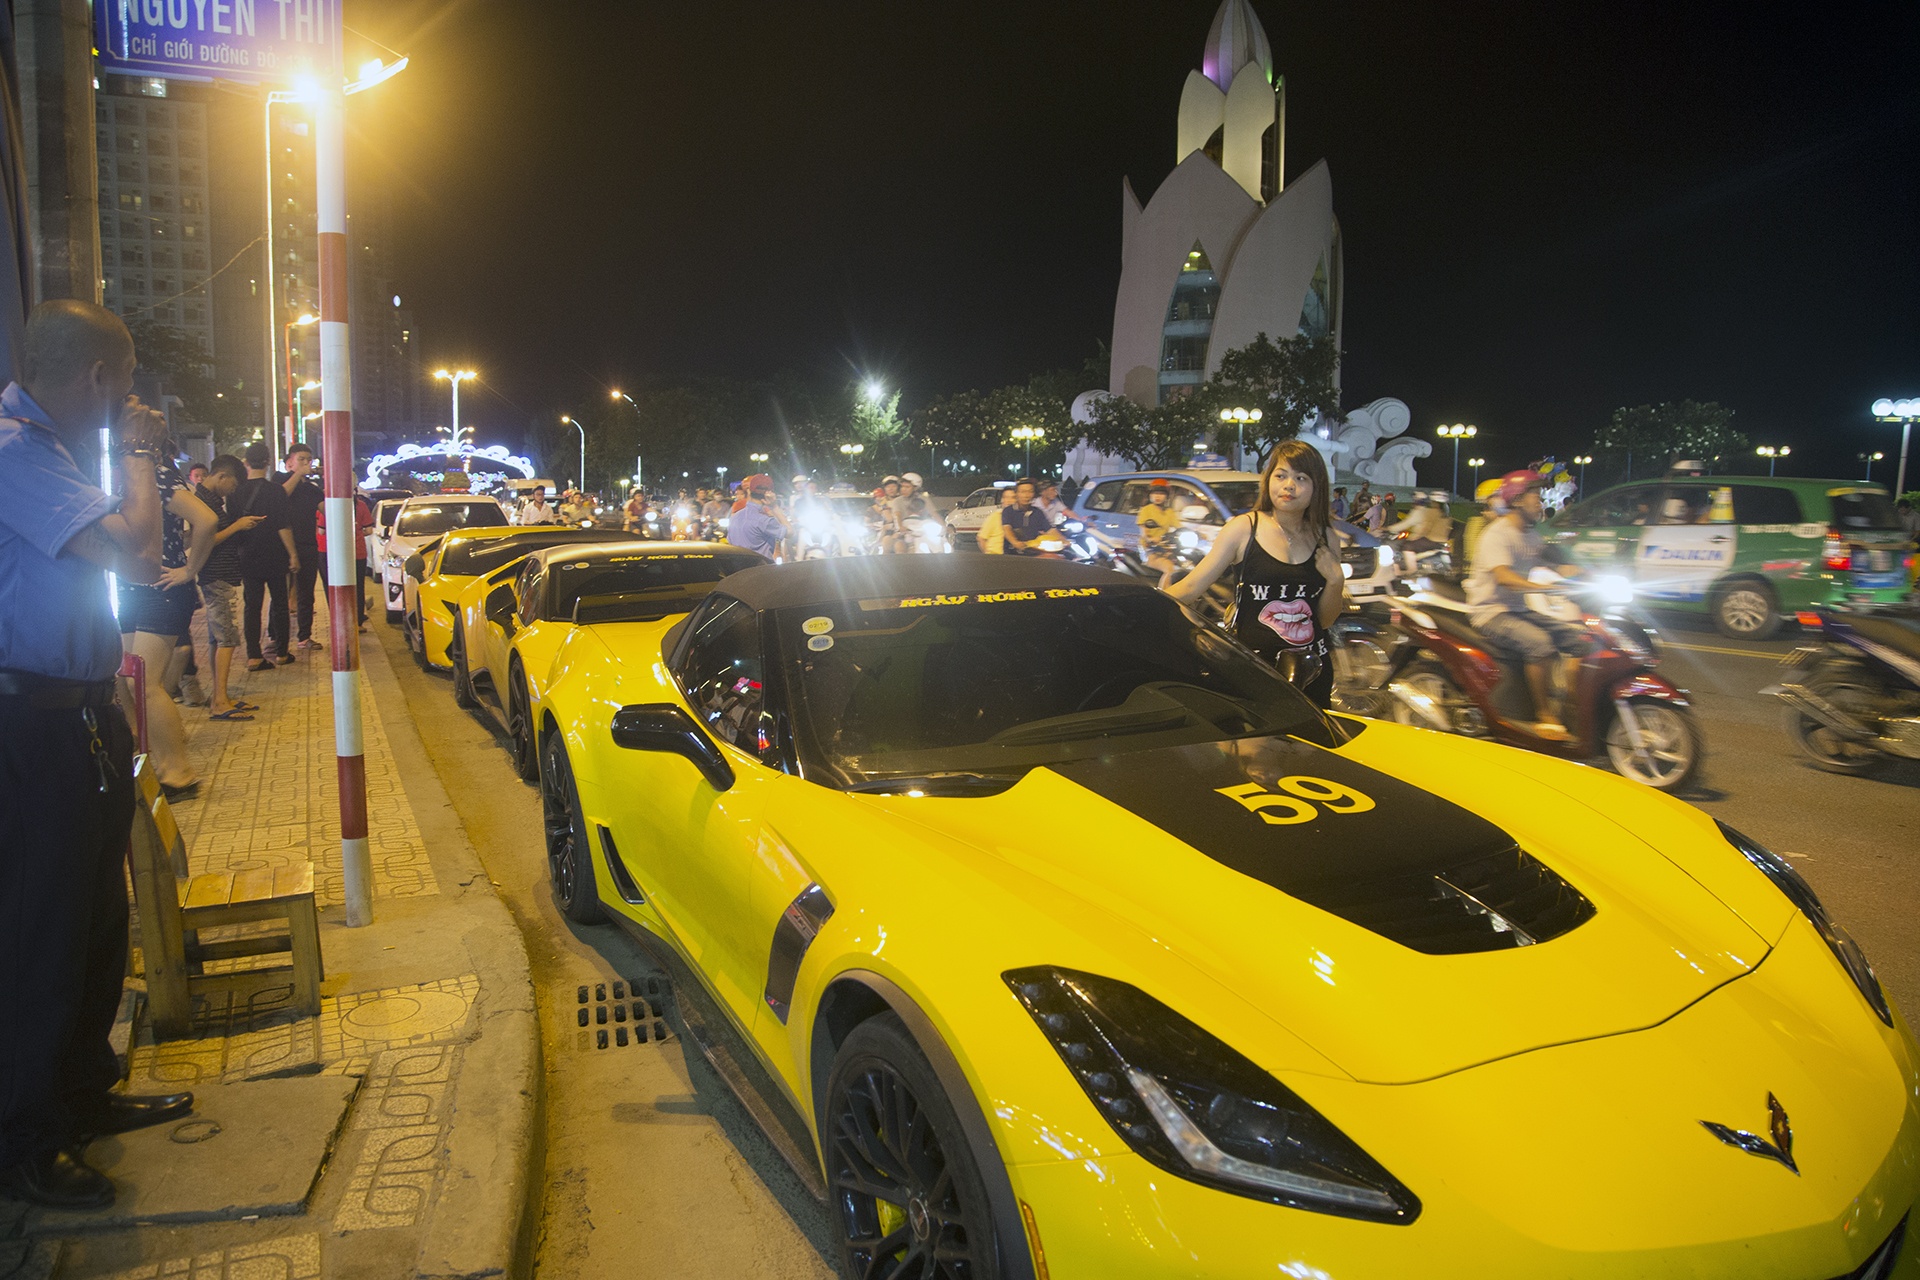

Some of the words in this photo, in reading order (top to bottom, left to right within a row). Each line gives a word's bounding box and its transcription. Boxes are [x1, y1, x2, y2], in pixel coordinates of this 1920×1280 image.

[131, 33, 157, 56] CHỈ
[164, 38, 194, 60] GIỚI
[200, 43, 249, 66] ĐƯỜNG
[1213, 775, 1377, 825] 59
